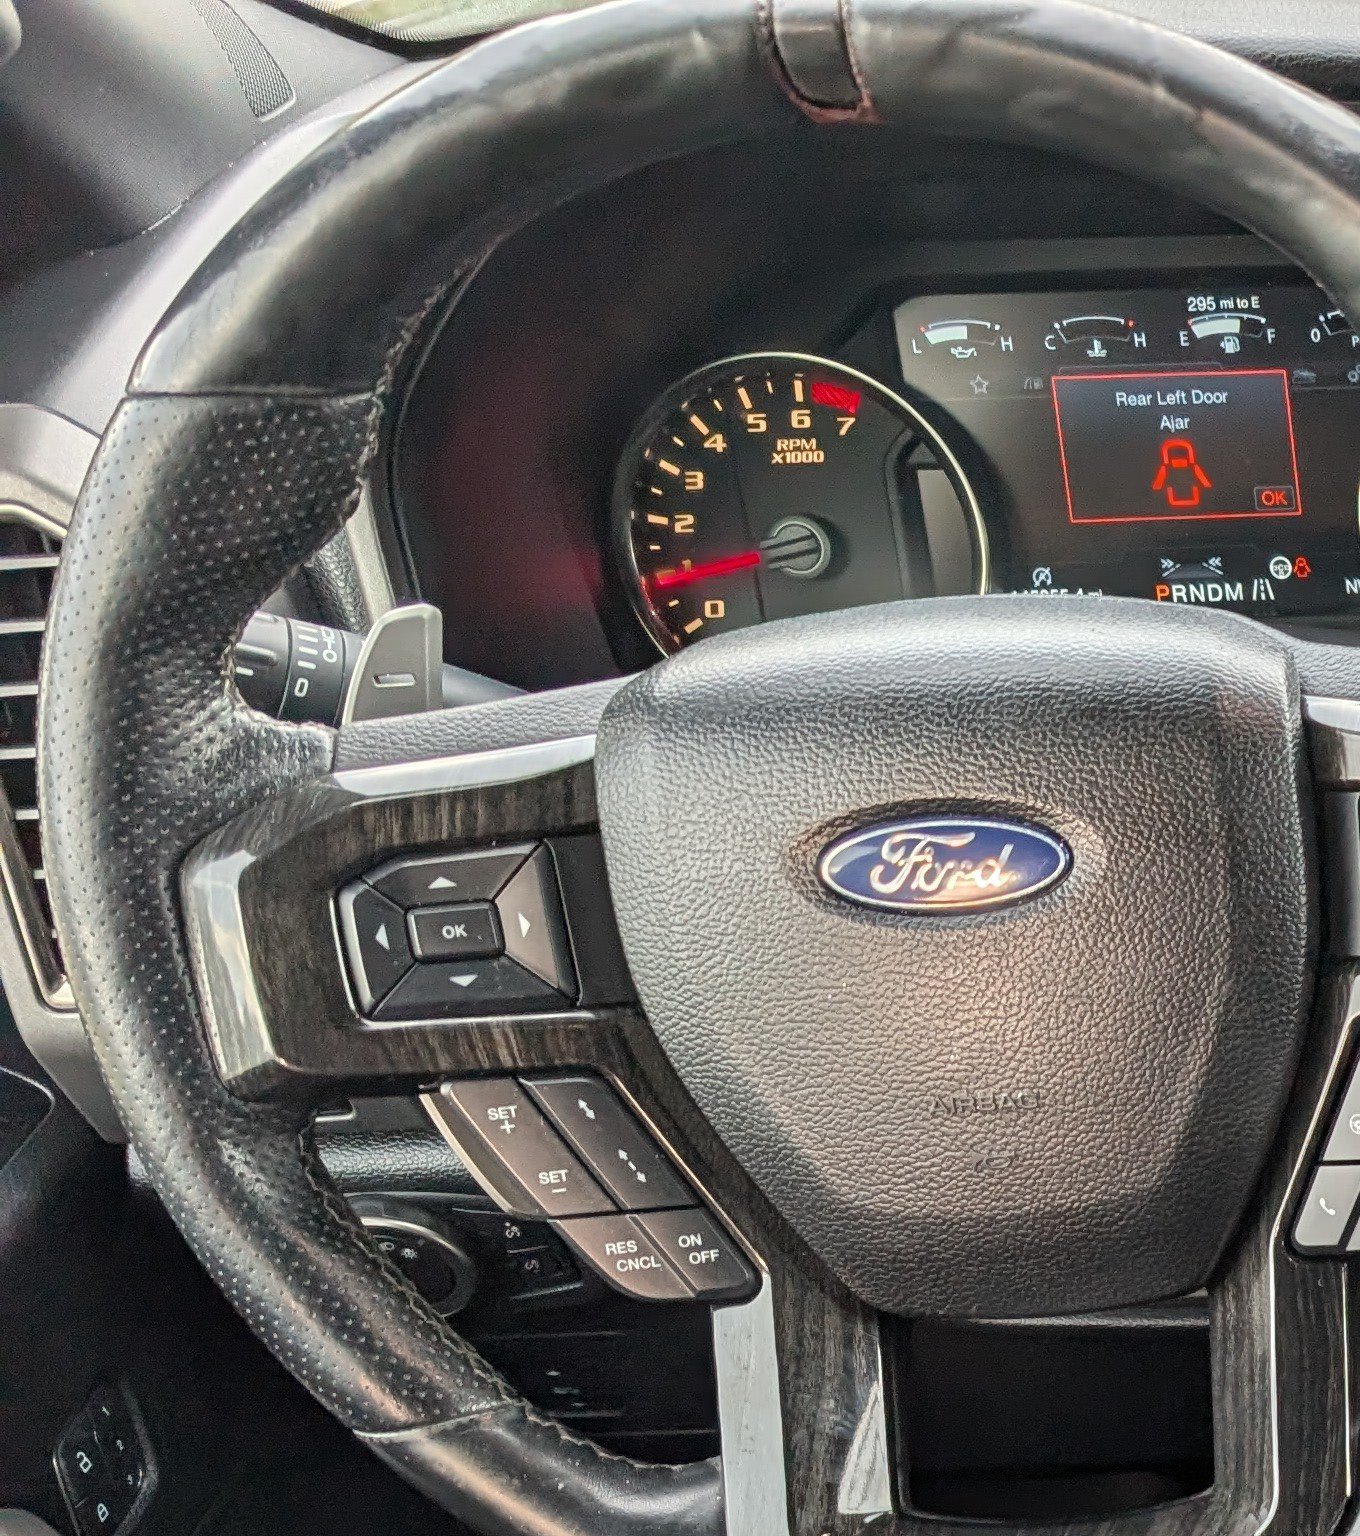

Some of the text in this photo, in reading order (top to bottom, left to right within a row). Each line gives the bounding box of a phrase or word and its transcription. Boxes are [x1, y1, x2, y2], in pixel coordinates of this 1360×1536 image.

[1187, 296, 1260, 312] 295 mi to E
[1000, 336, 1014, 352] H
[1044, 334, 1057, 351] C
[1133, 332, 1147, 348] H
[1179, 330, 1189, 347] E
[1267, 328, 1276, 344] F
[912, 338, 922, 354] L
[1115, 389, 1228, 407] Rear Left Door
[747, 413, 767, 433] 5
[790, 409, 811, 429] 6
[836, 417, 855, 436] 7
[1159, 415, 1190, 432] Ajar
[703, 433, 727, 452] 4
[776, 438, 817, 451] RPM
[684, 471, 704, 491] 3
[1261, 491, 1288, 506] OK
[674, 514, 695, 533] 2
[704, 600, 725, 618] 0
[442, 924, 467, 939] OK
[930, 1092, 1040, 1116] AIRBAG
[487, 1106, 518, 1121] SET
[538, 1169, 569, 1185] SET
[605, 1240, 639, 1256] RES
[678, 1233, 703, 1247] ON
[616, 1255, 663, 1273] CNCL
[688, 1249, 720, 1265] OFF
[116, 1439, 125, 1451] 2
